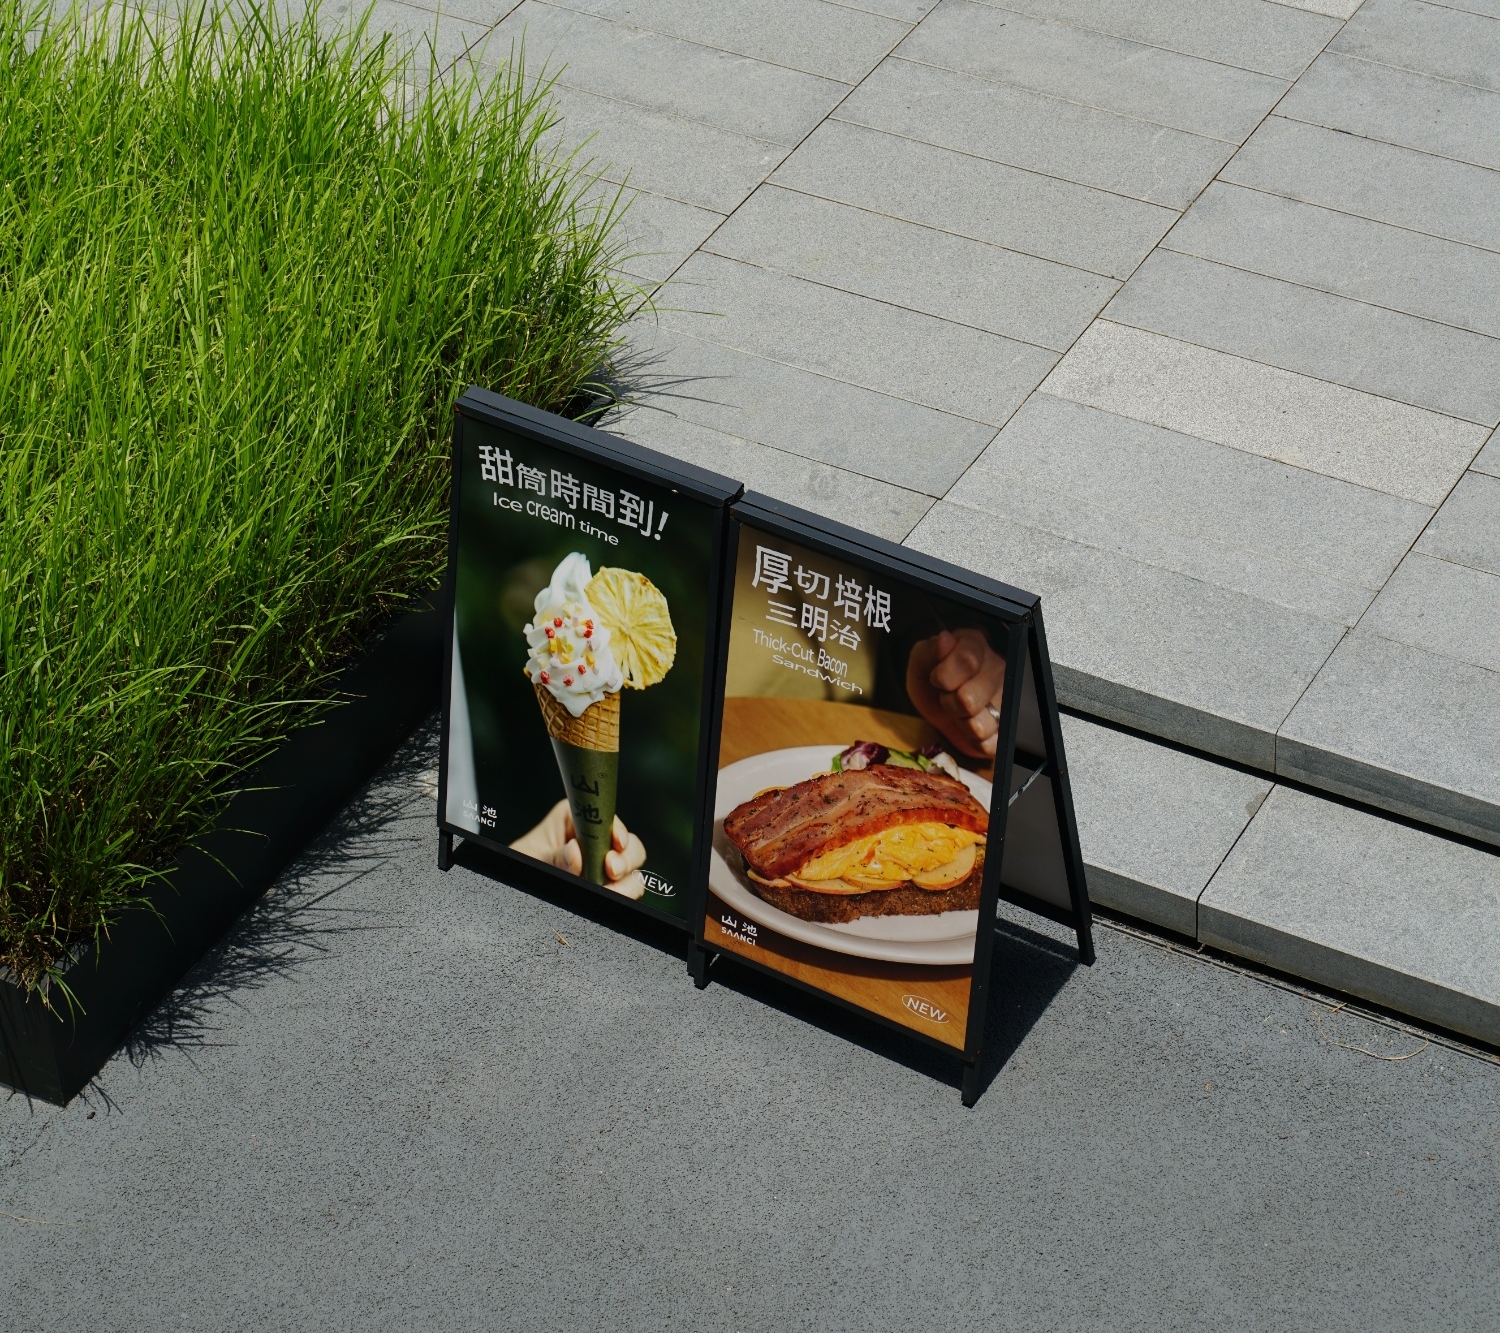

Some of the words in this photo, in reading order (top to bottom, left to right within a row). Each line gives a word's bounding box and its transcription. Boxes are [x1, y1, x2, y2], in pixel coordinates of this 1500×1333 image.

[478, 445, 669, 541] 甜筒時間到!
[493, 492, 523, 512] Ice
[526, 500, 575, 530] cream
[579, 520, 619, 546] time
[752, 545, 891, 633] 厚切培根
[766, 600, 861, 651] 三明治
[753, 628, 815, 663] Thick-Cut
[817, 648, 848, 677] Bacon
[772, 654, 863, 695] Sandwich
[462, 810, 496, 828] SAANCI
[636, 872, 674, 895] NEW
[721, 926, 756, 946] SAANCI
[906, 996, 947, 1021] NEW
